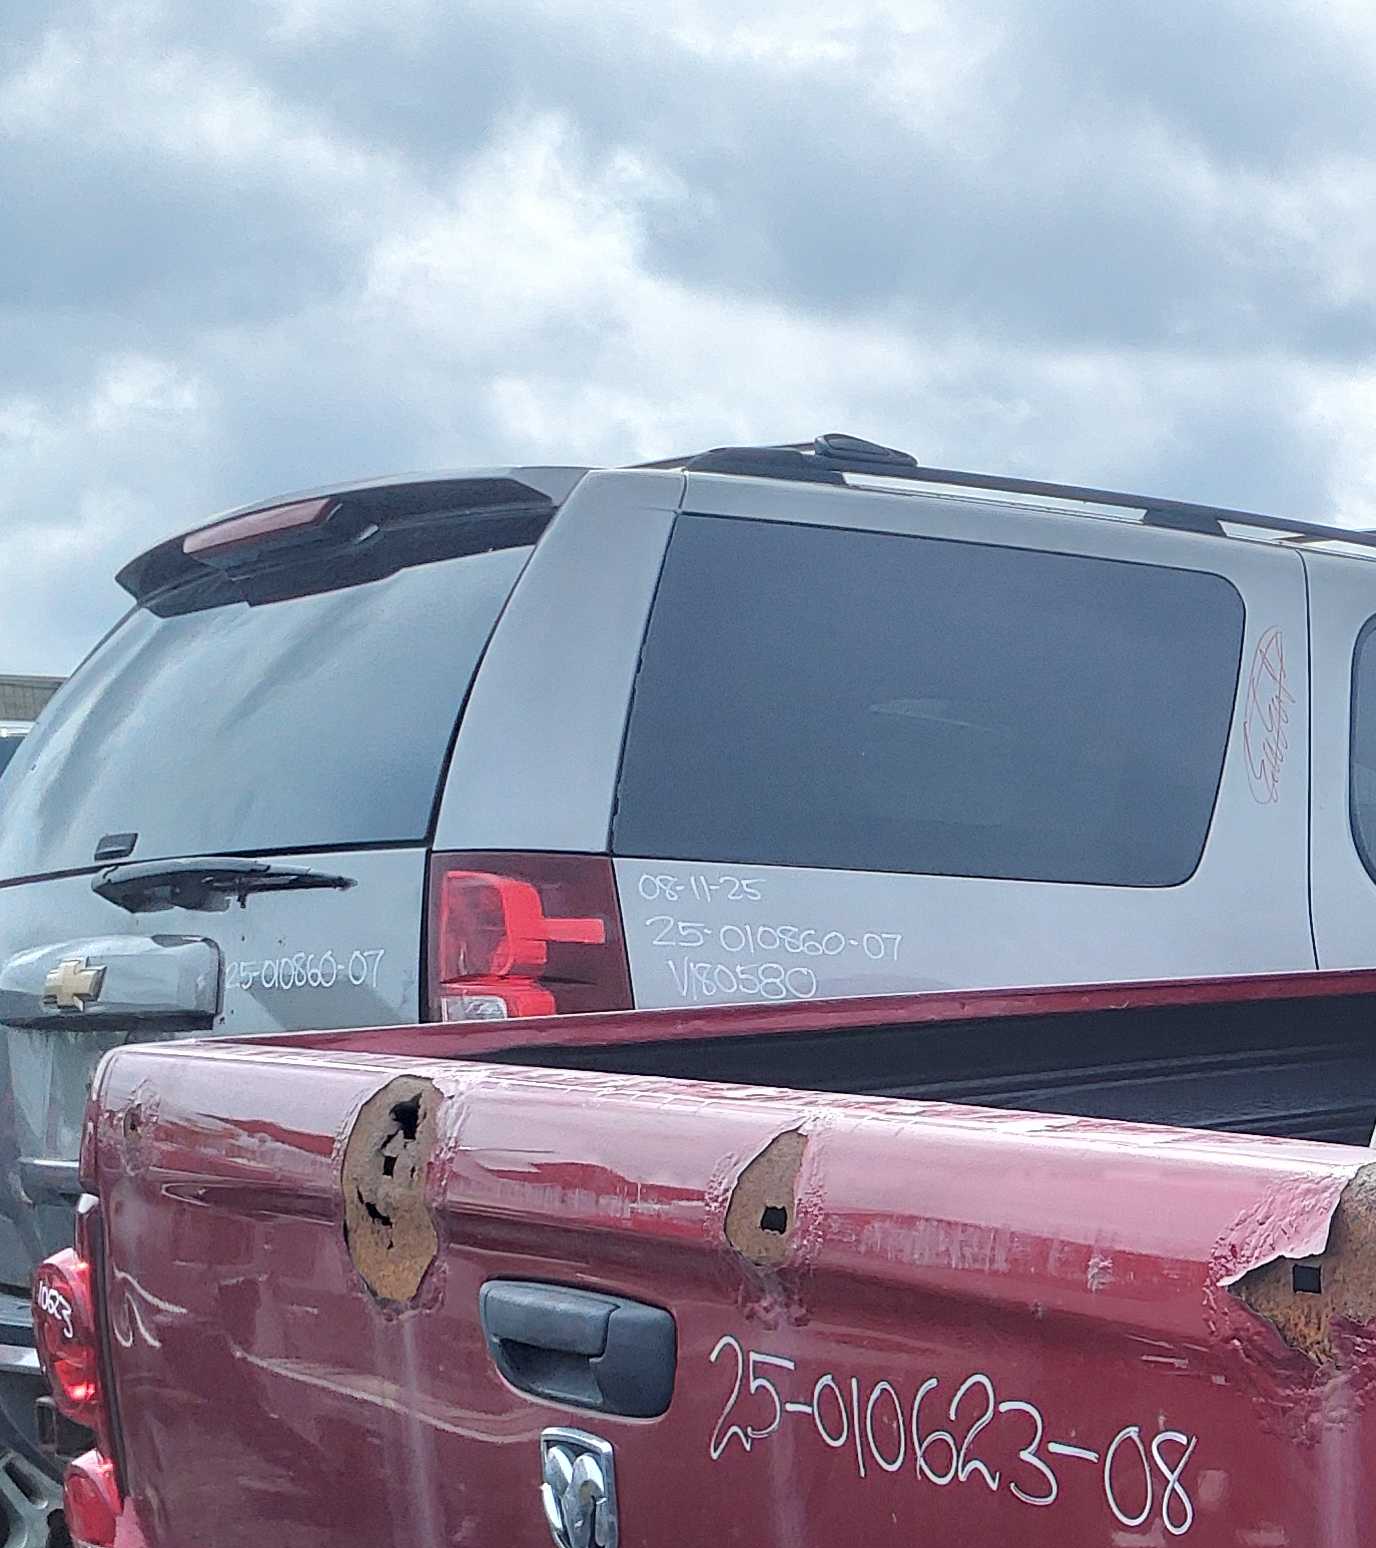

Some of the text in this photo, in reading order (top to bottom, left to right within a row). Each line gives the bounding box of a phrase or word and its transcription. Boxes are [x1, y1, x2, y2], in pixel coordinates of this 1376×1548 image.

[639, 874, 767, 901] 08-11-25
[646, 915, 902, 961] 25-010860-07
[709, 1334, 1198, 1536] 25-010623-08
